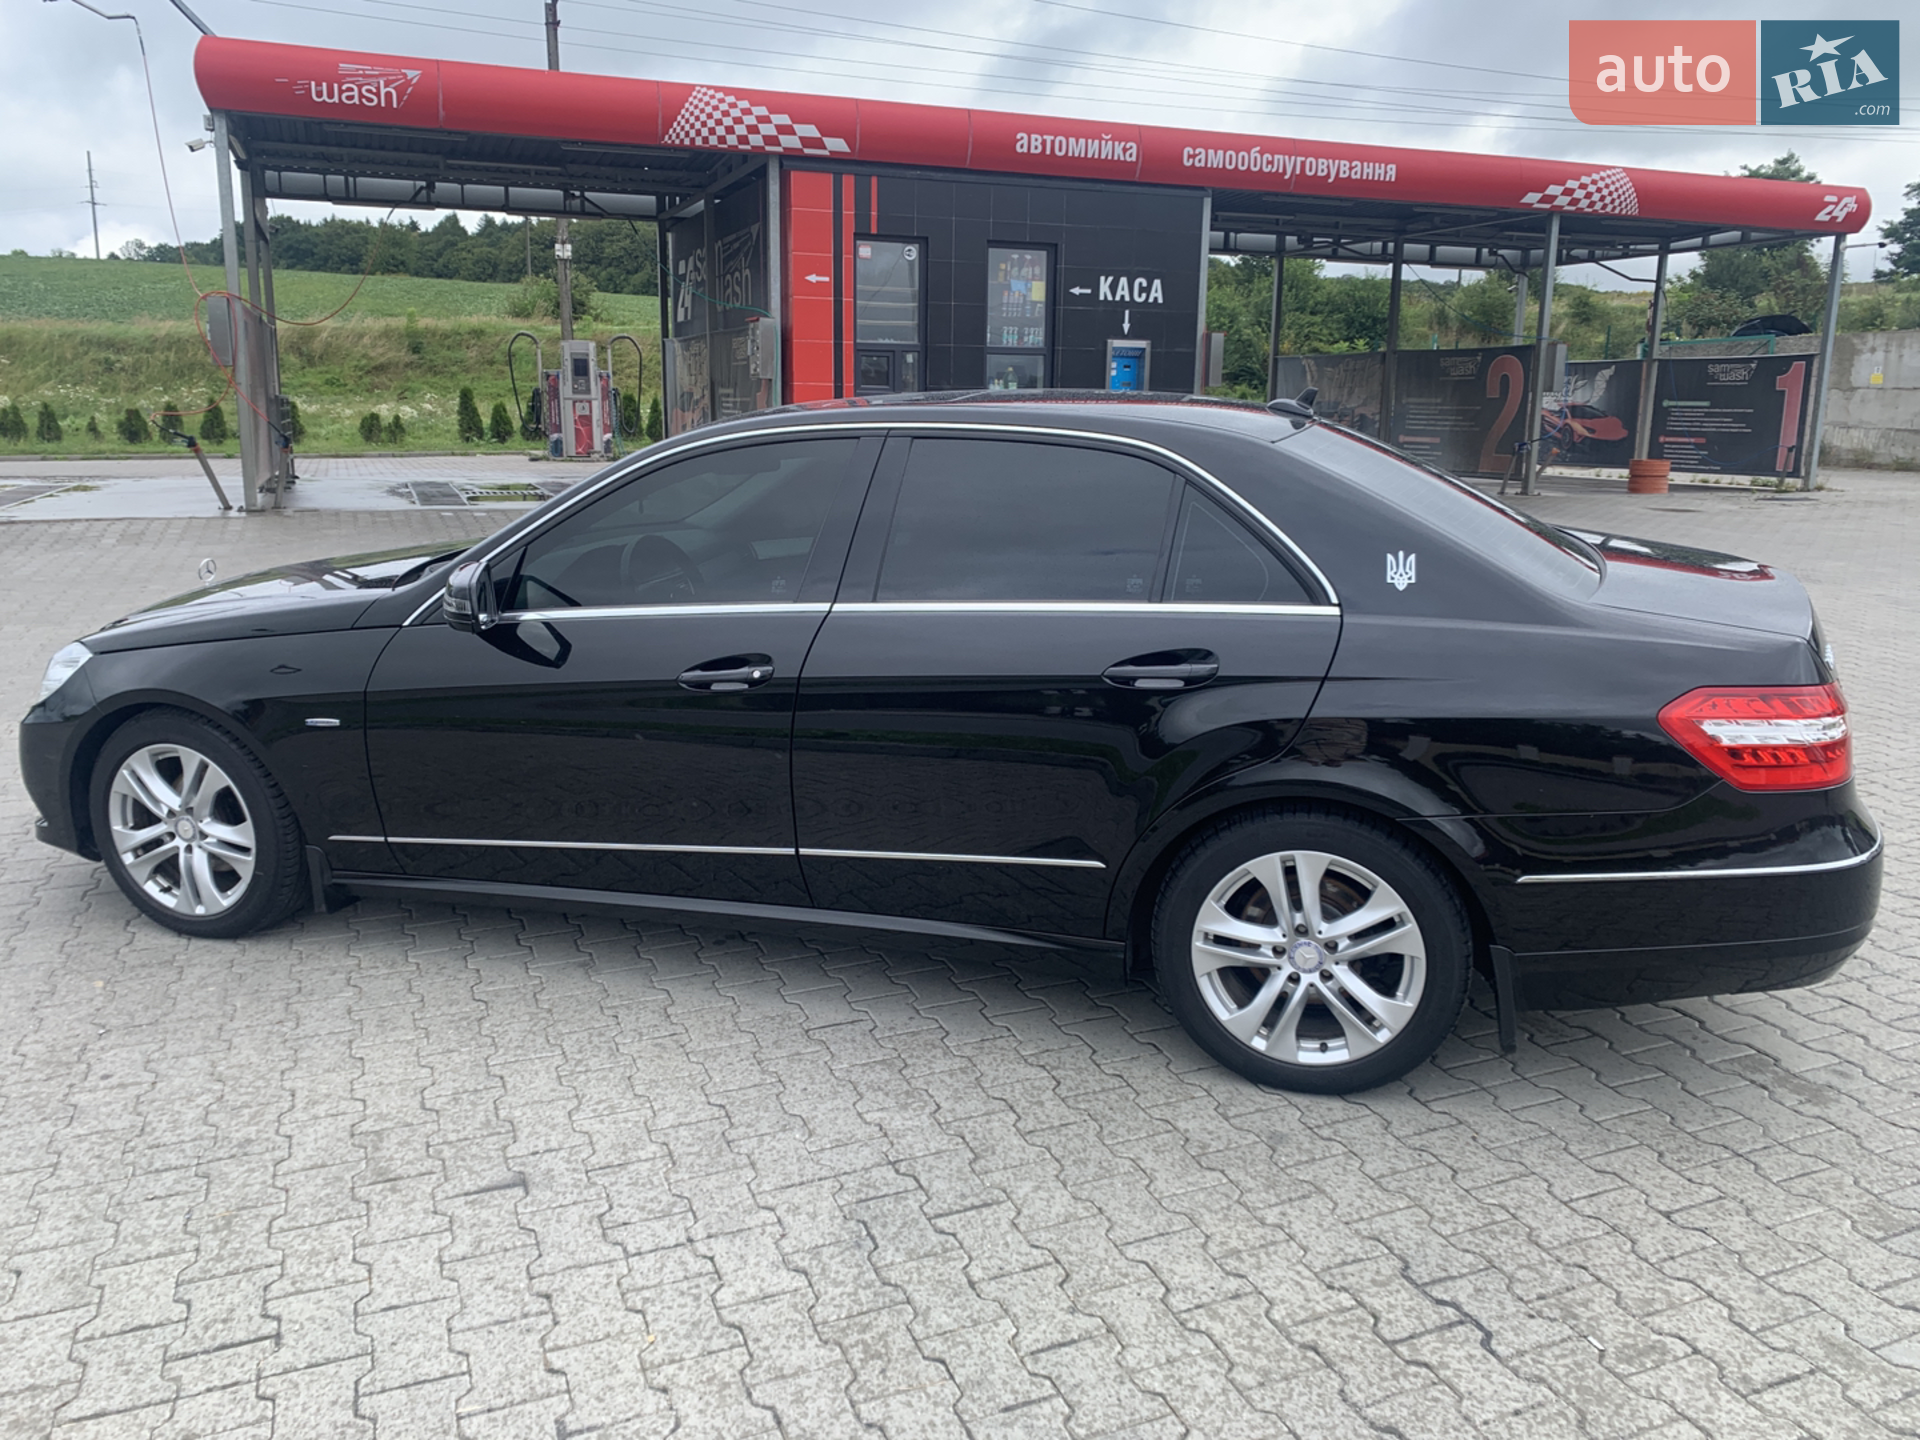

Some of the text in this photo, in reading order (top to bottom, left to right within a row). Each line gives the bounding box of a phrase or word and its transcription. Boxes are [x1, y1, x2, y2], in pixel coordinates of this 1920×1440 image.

[311, 80, 397, 108] wash
[1016, 132, 1397, 182] автомийка самообслуговування
[1099, 275, 1163, 303] КАСА
[1707, 363, 1730, 373] sam
[1719, 369, 1749, 381] wash
[1479, 354, 1524, 473] 2
[1775, 361, 1806, 472] 1
